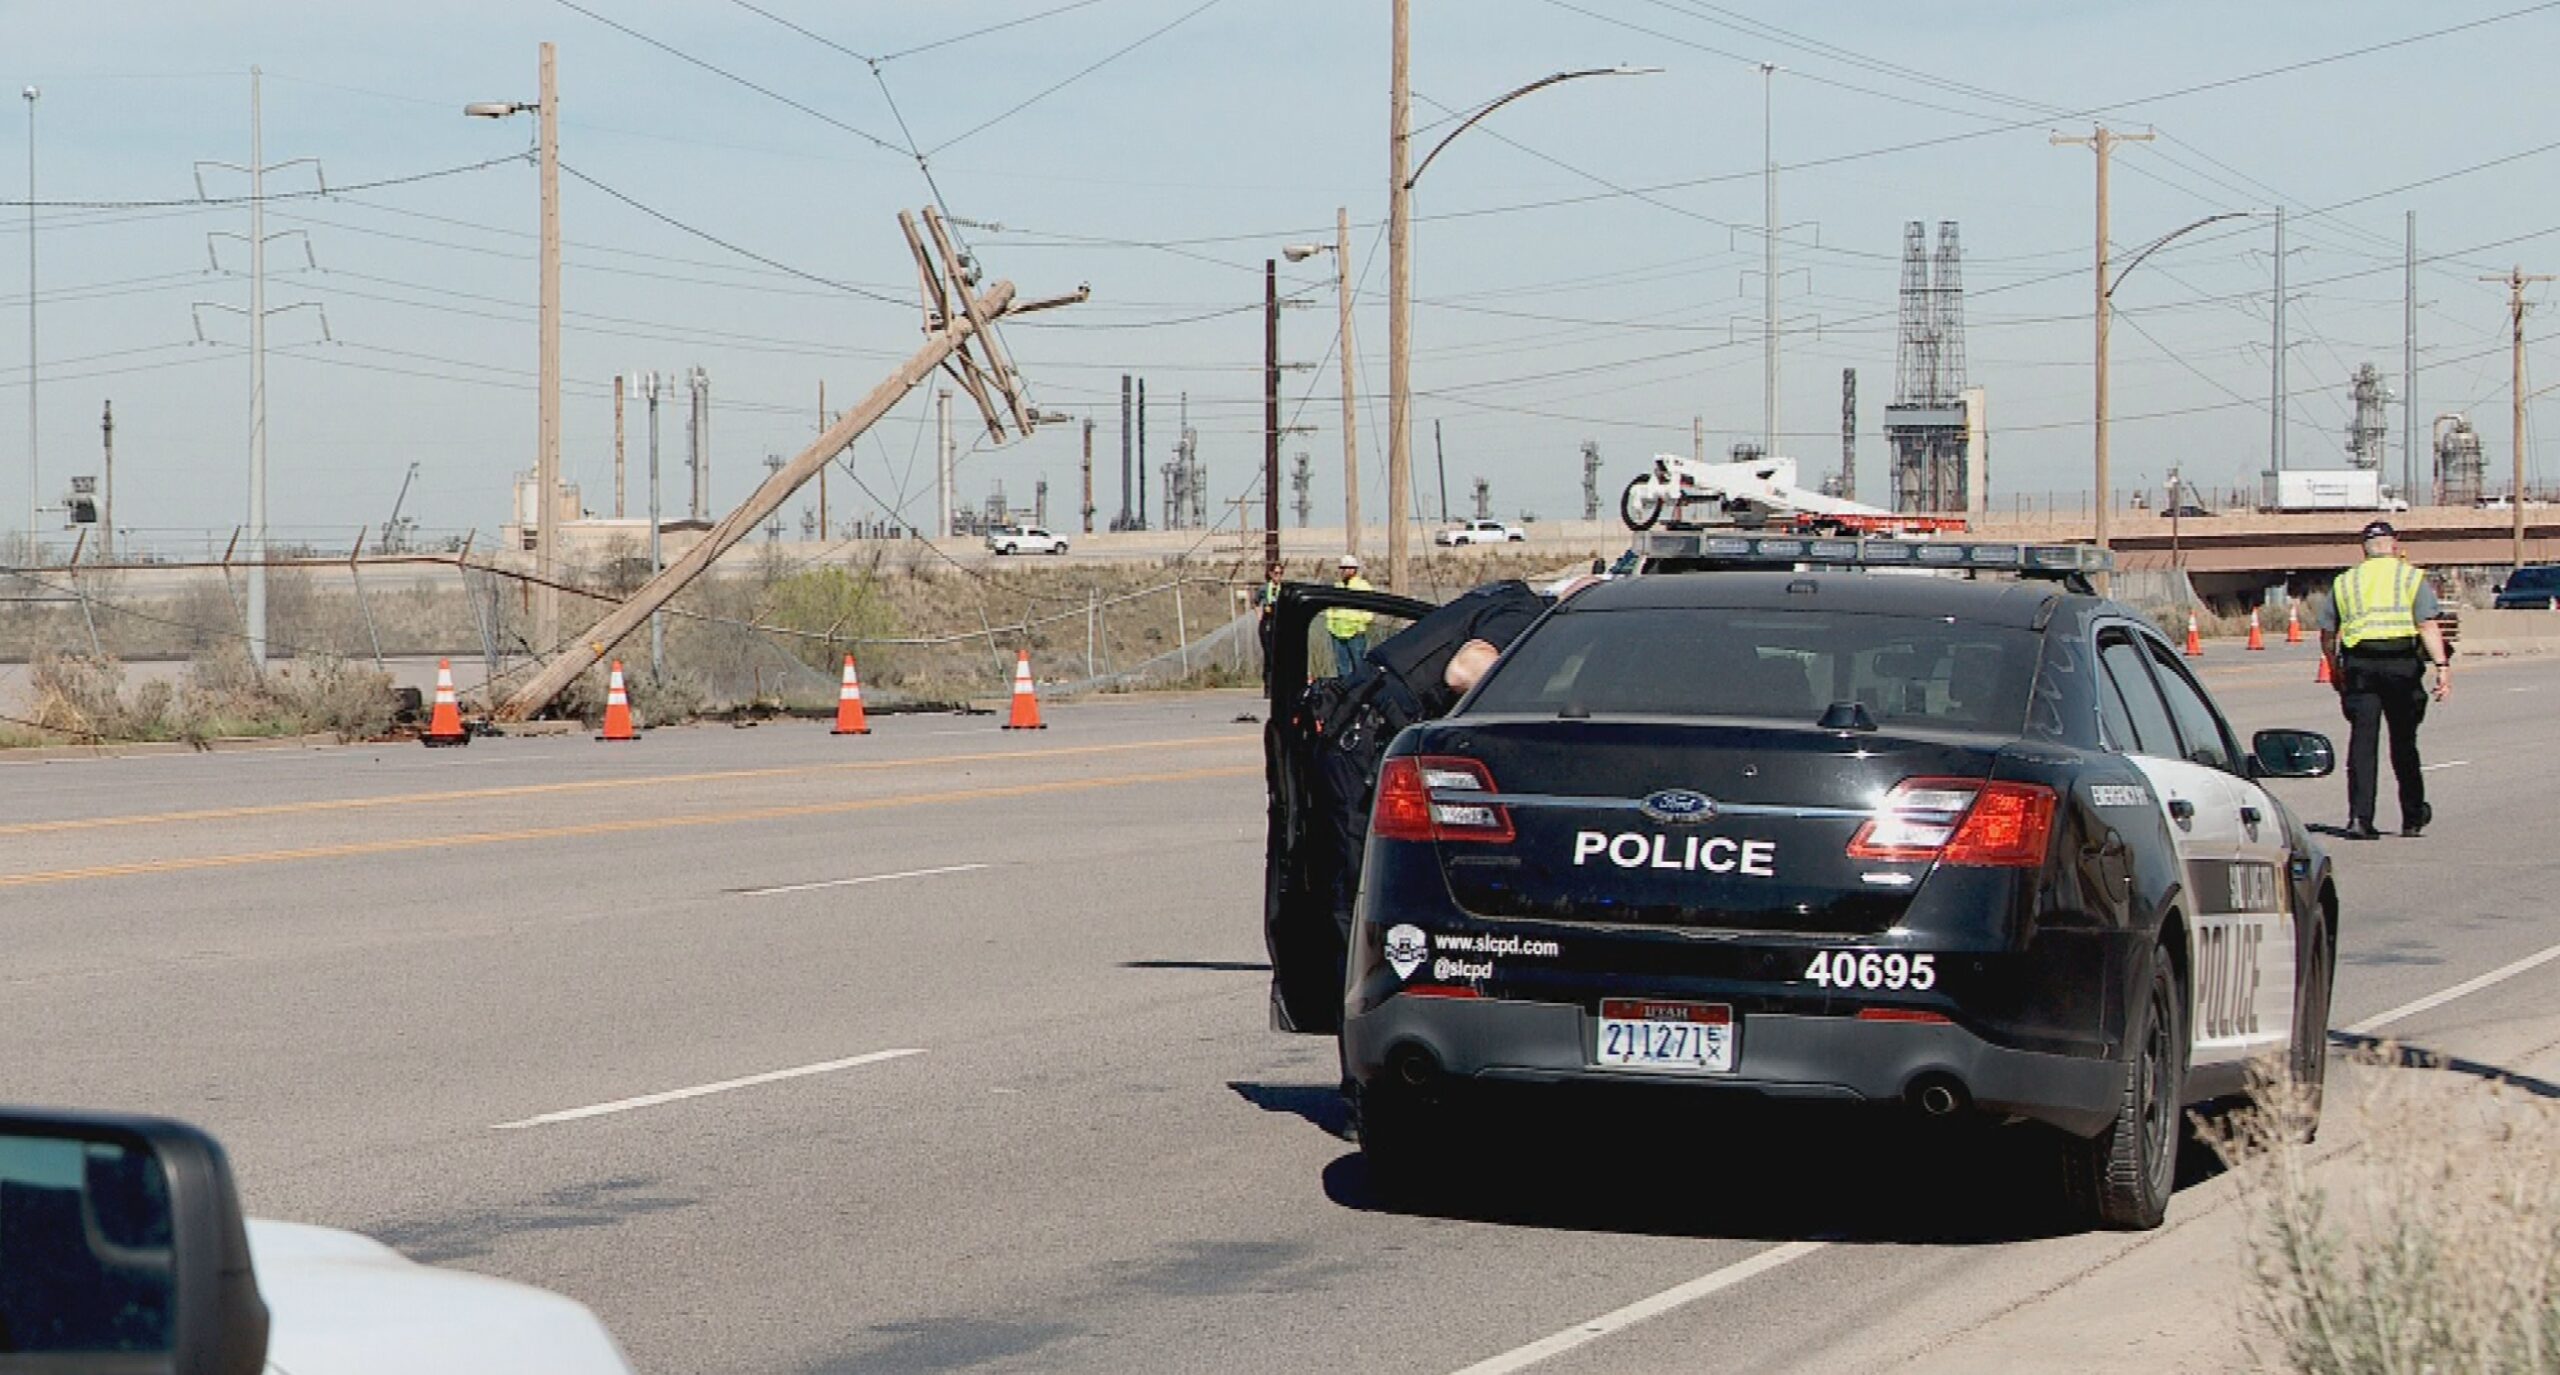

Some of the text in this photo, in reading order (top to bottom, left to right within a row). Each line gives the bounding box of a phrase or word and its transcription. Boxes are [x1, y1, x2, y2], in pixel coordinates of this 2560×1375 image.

[1573, 831, 1776, 876] POLICE
[1434, 932, 1559, 957] www.slcpd.com
[1434, 956, 1492, 981] @slcpd
[1804, 950, 1936, 990] 40695
[2195, 922, 2263, 1041] POLICE
[1644, 1005, 1689, 1019] UTAH
[1606, 1024, 1702, 1058] 211271
